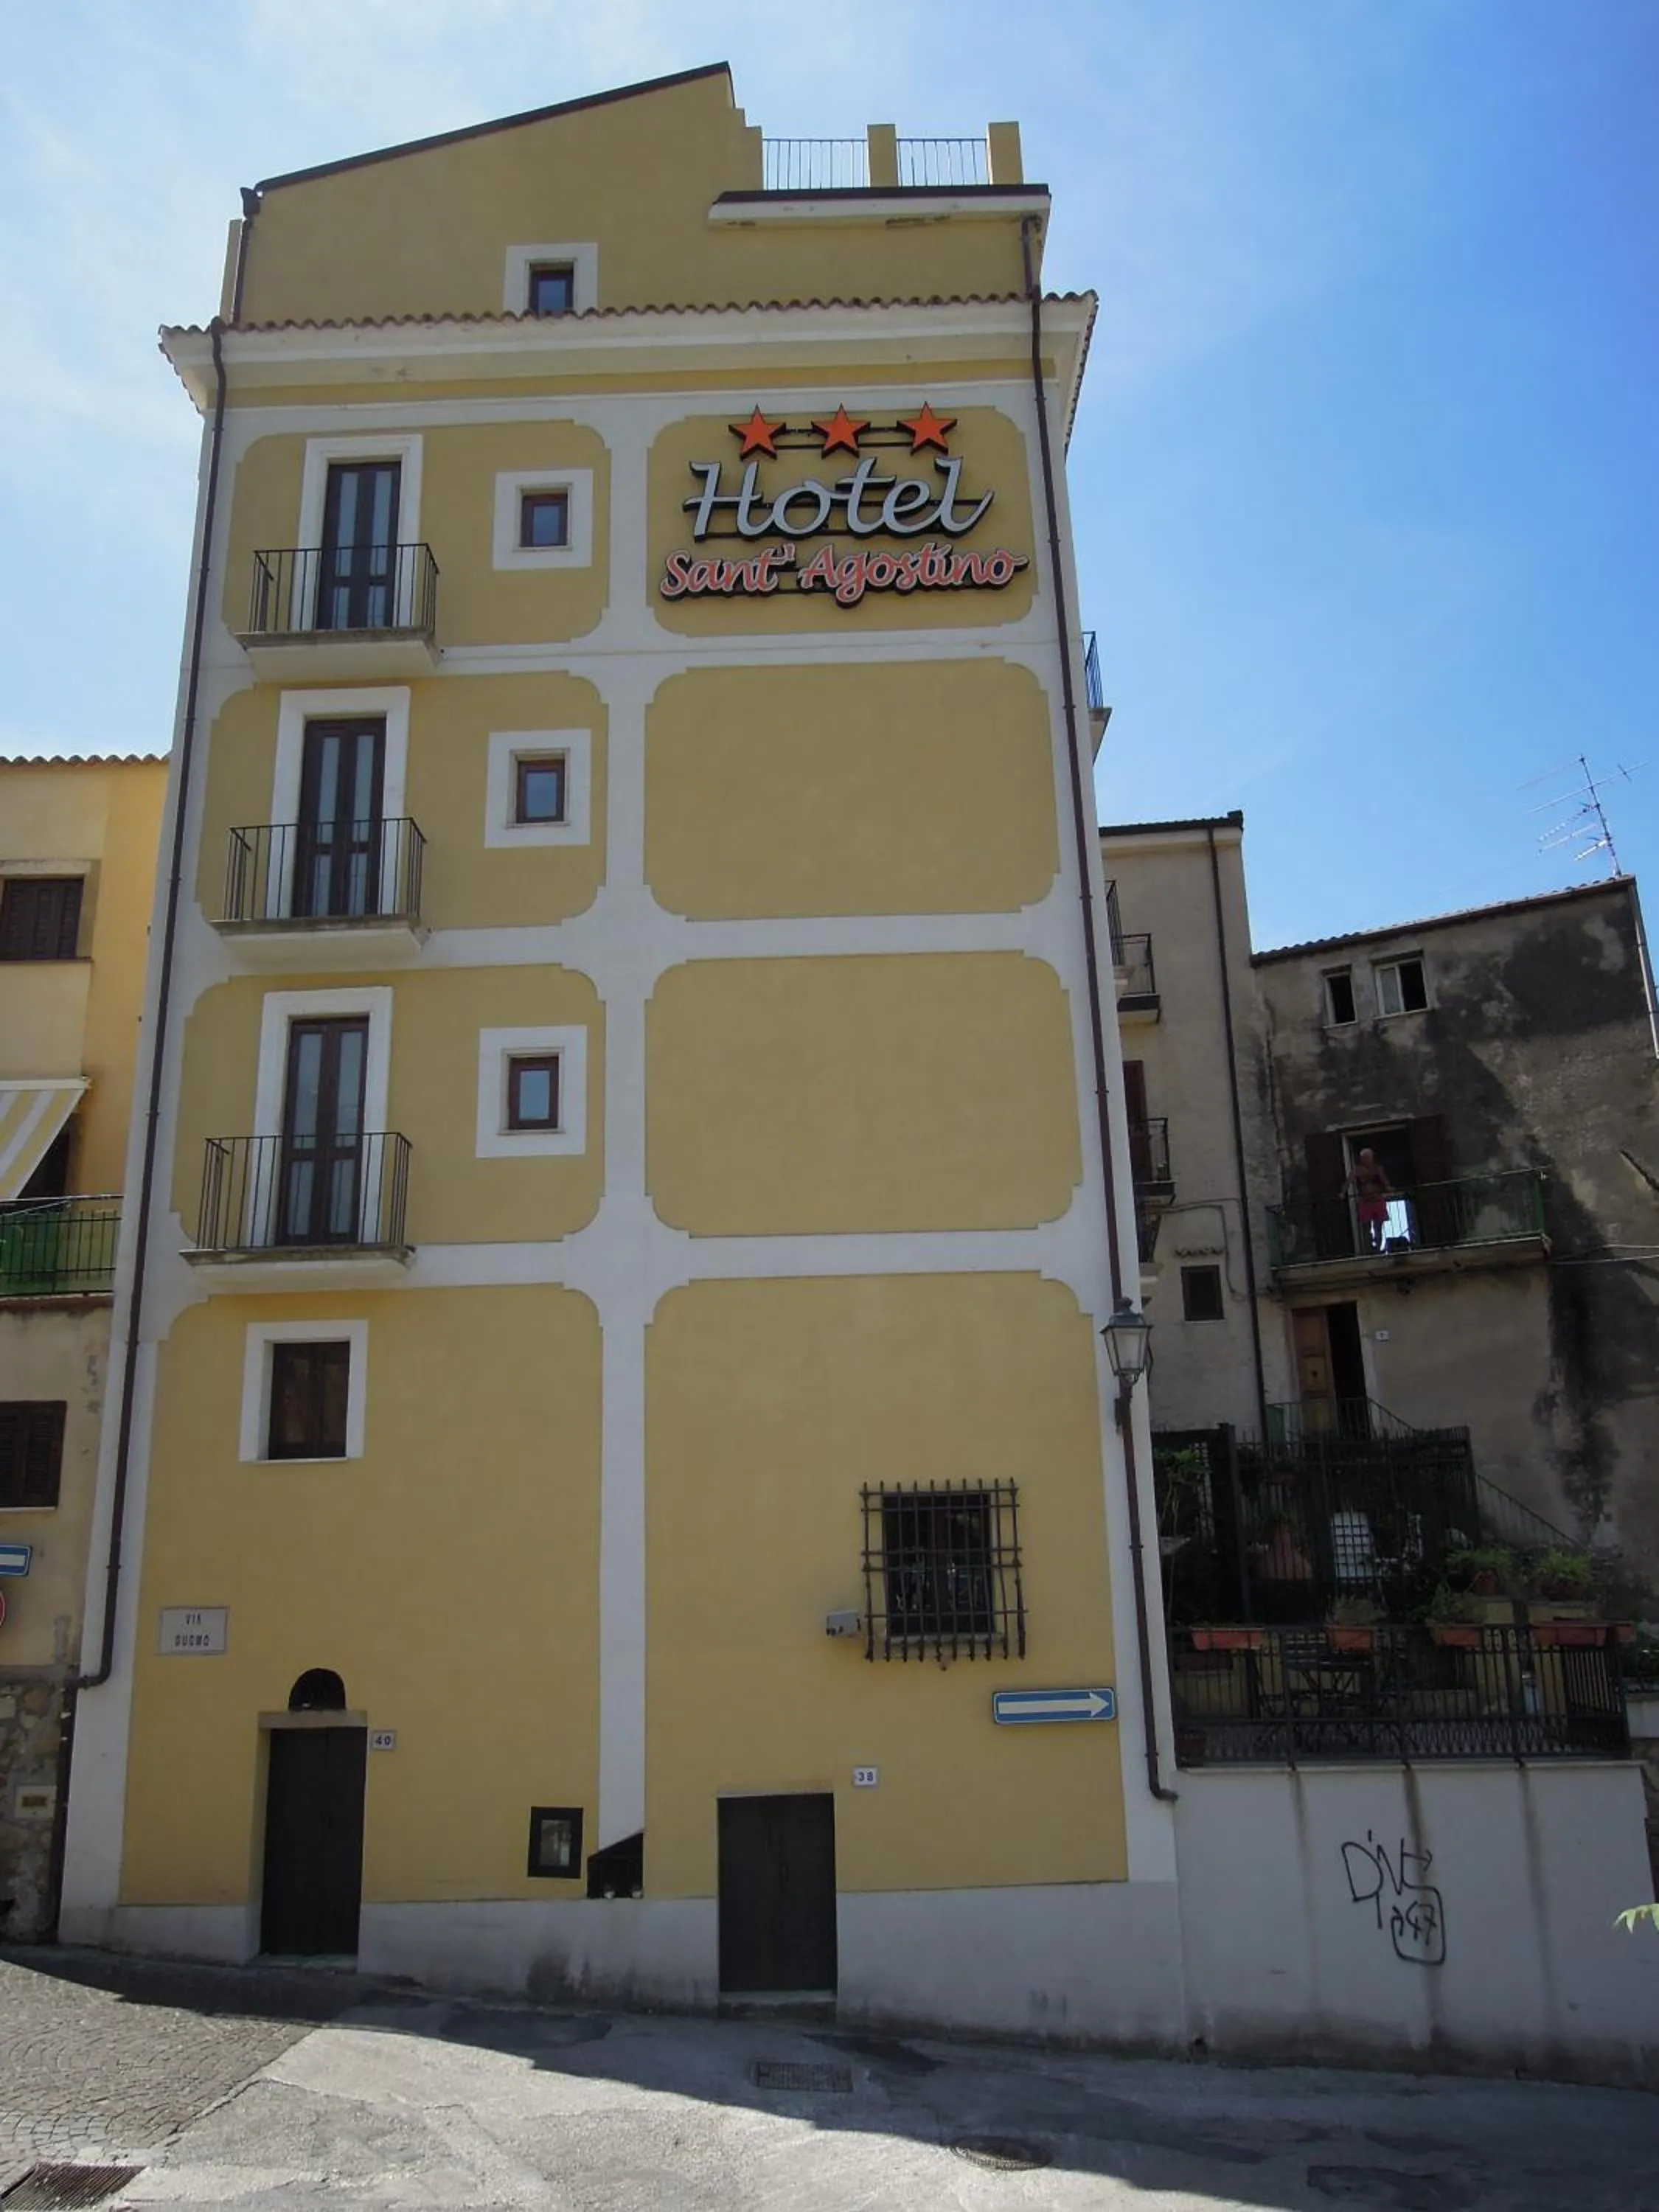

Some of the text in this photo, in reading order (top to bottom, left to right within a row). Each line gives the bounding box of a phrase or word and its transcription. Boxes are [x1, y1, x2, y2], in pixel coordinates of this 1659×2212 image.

[683, 456, 994, 543] Hotel
[661, 541, 1029, 608] Sant' Agostino
[185, 1613, 201, 1625] VIA
[375, 1735, 392, 1746] 40
[858, 1771, 874, 1782] 38
